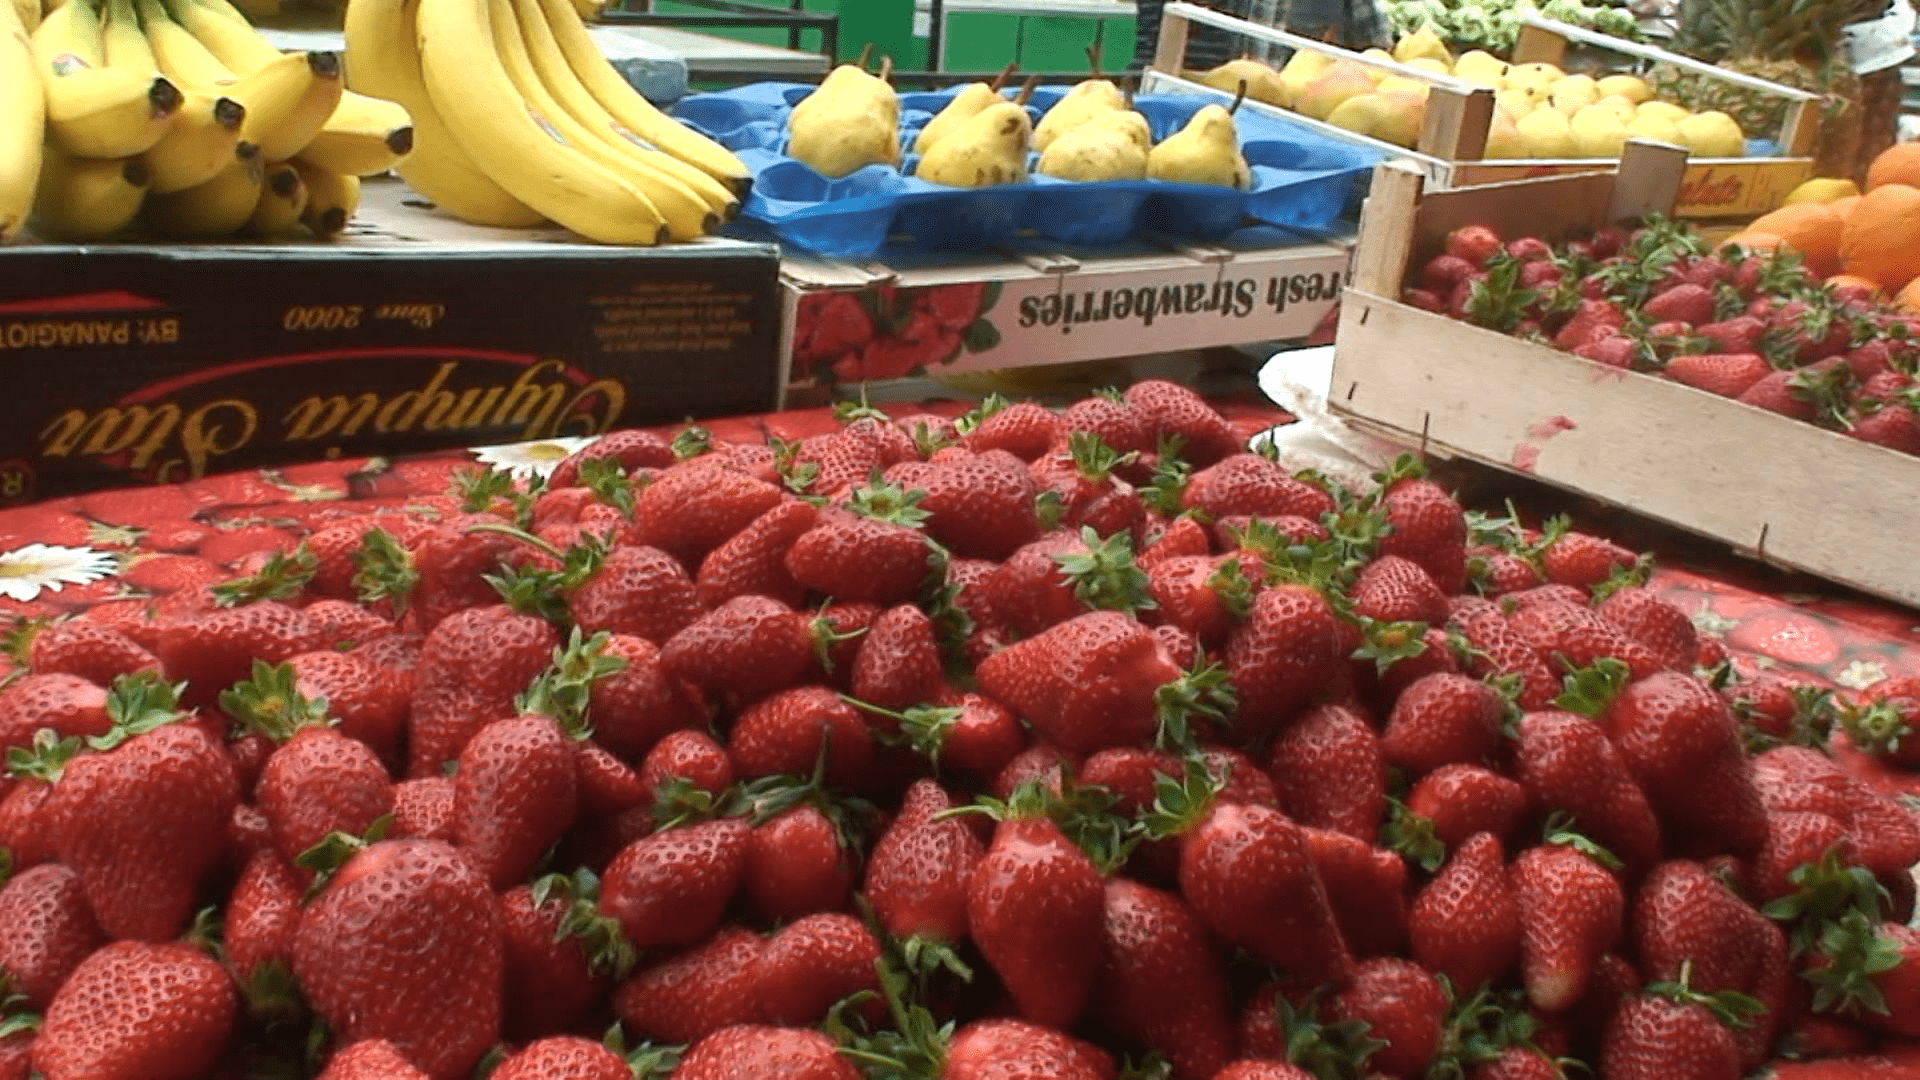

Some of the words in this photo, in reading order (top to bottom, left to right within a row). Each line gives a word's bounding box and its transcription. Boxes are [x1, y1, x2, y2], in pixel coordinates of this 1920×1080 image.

[1019, 279, 1257, 334] Strawberries
[1267, 271, 1347, 314] resh
[137, 319, 180, 344] BY:
[283, 305, 364, 331] 2000
[376, 304, 448, 329] Since
[281, 359, 626, 459] Olympia
[38, 400, 258, 478] Star
